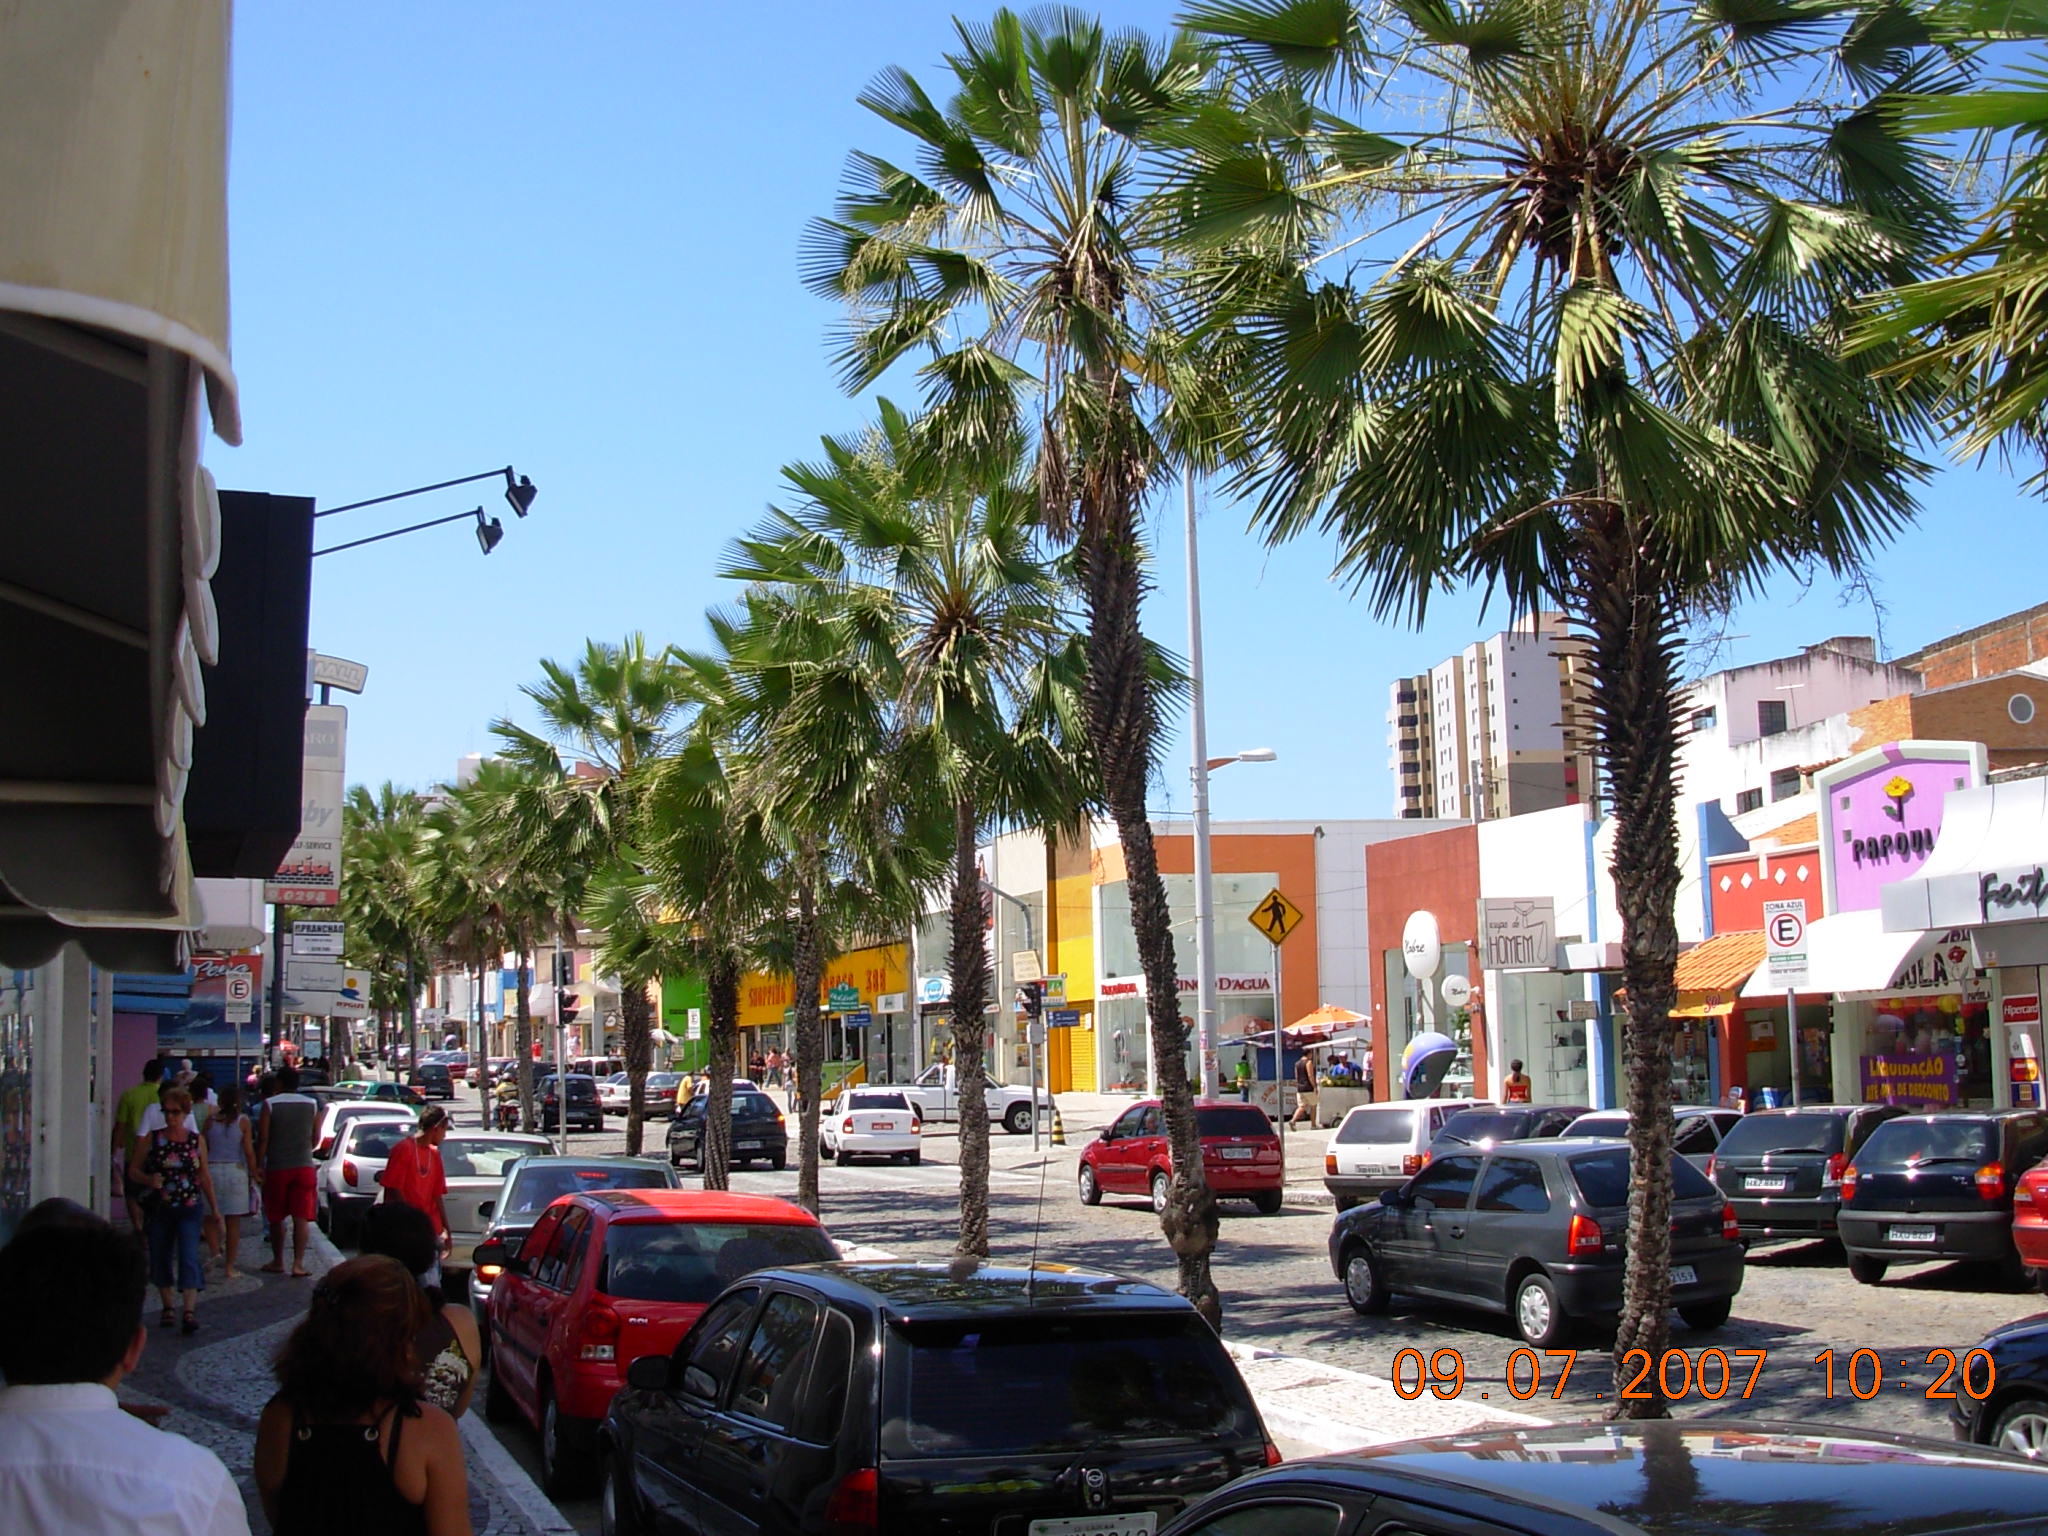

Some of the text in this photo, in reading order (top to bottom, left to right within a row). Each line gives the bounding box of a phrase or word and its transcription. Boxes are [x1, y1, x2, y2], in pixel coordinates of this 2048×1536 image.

[1765, 902, 1785, 911] ZONA
[1786, 901, 1803, 909] AZUL
[1777, 918, 1795, 942] E
[1489, 935, 1535, 965] HOMEM
[234, 982, 244, 996] E
[2003, 1004, 2040, 1017] Hipercard
